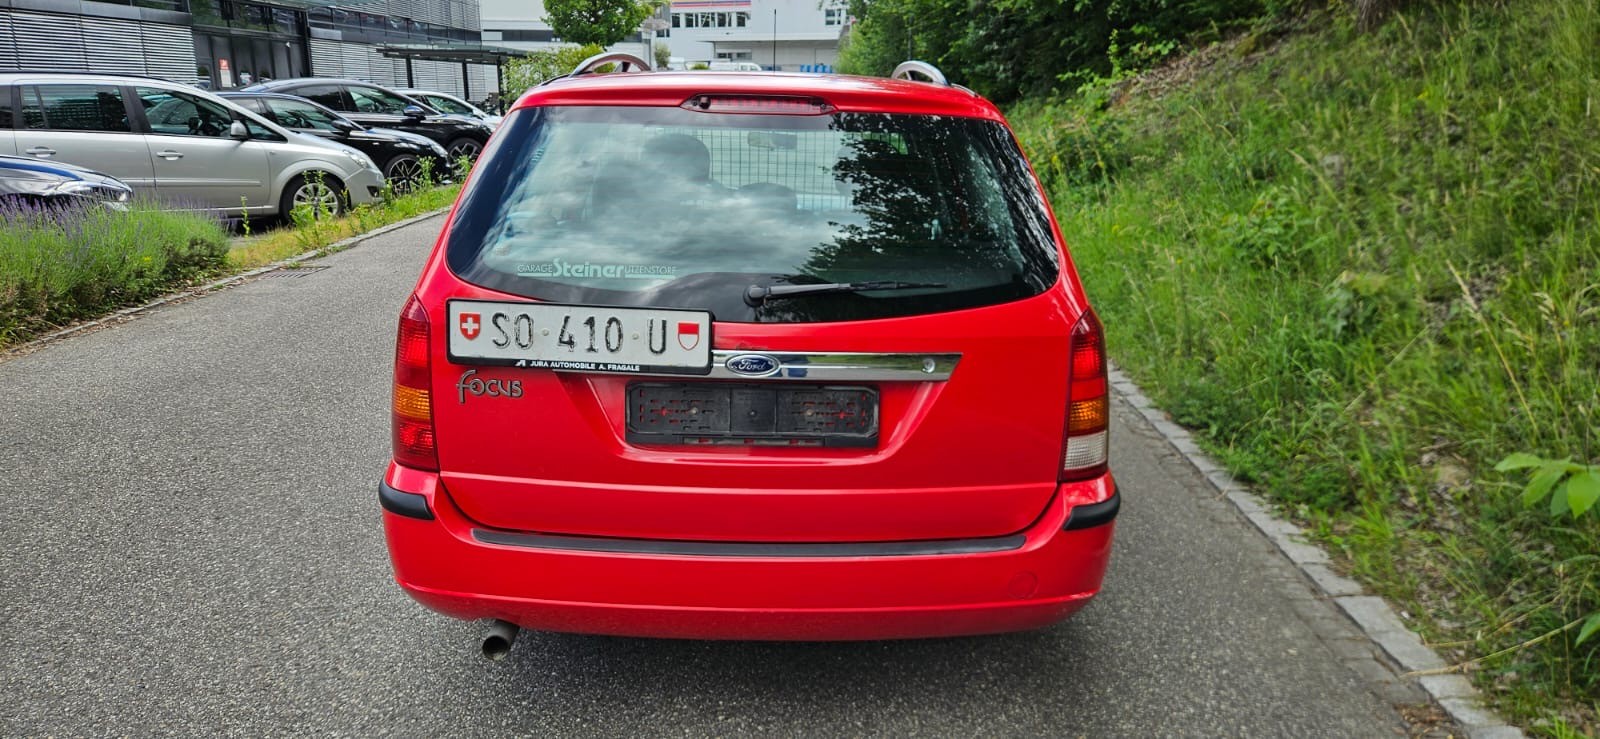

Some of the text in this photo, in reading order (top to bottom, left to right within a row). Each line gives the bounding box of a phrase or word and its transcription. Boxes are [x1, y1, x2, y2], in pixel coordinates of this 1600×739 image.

[517, 264, 553, 273] GARAGE
[552, 257, 624, 278] Steiner
[491, 312, 667, 354] SO 410 U
[550, 362, 596, 370] AUTOMOBILE
[607, 364, 640, 372] FRAGALE
